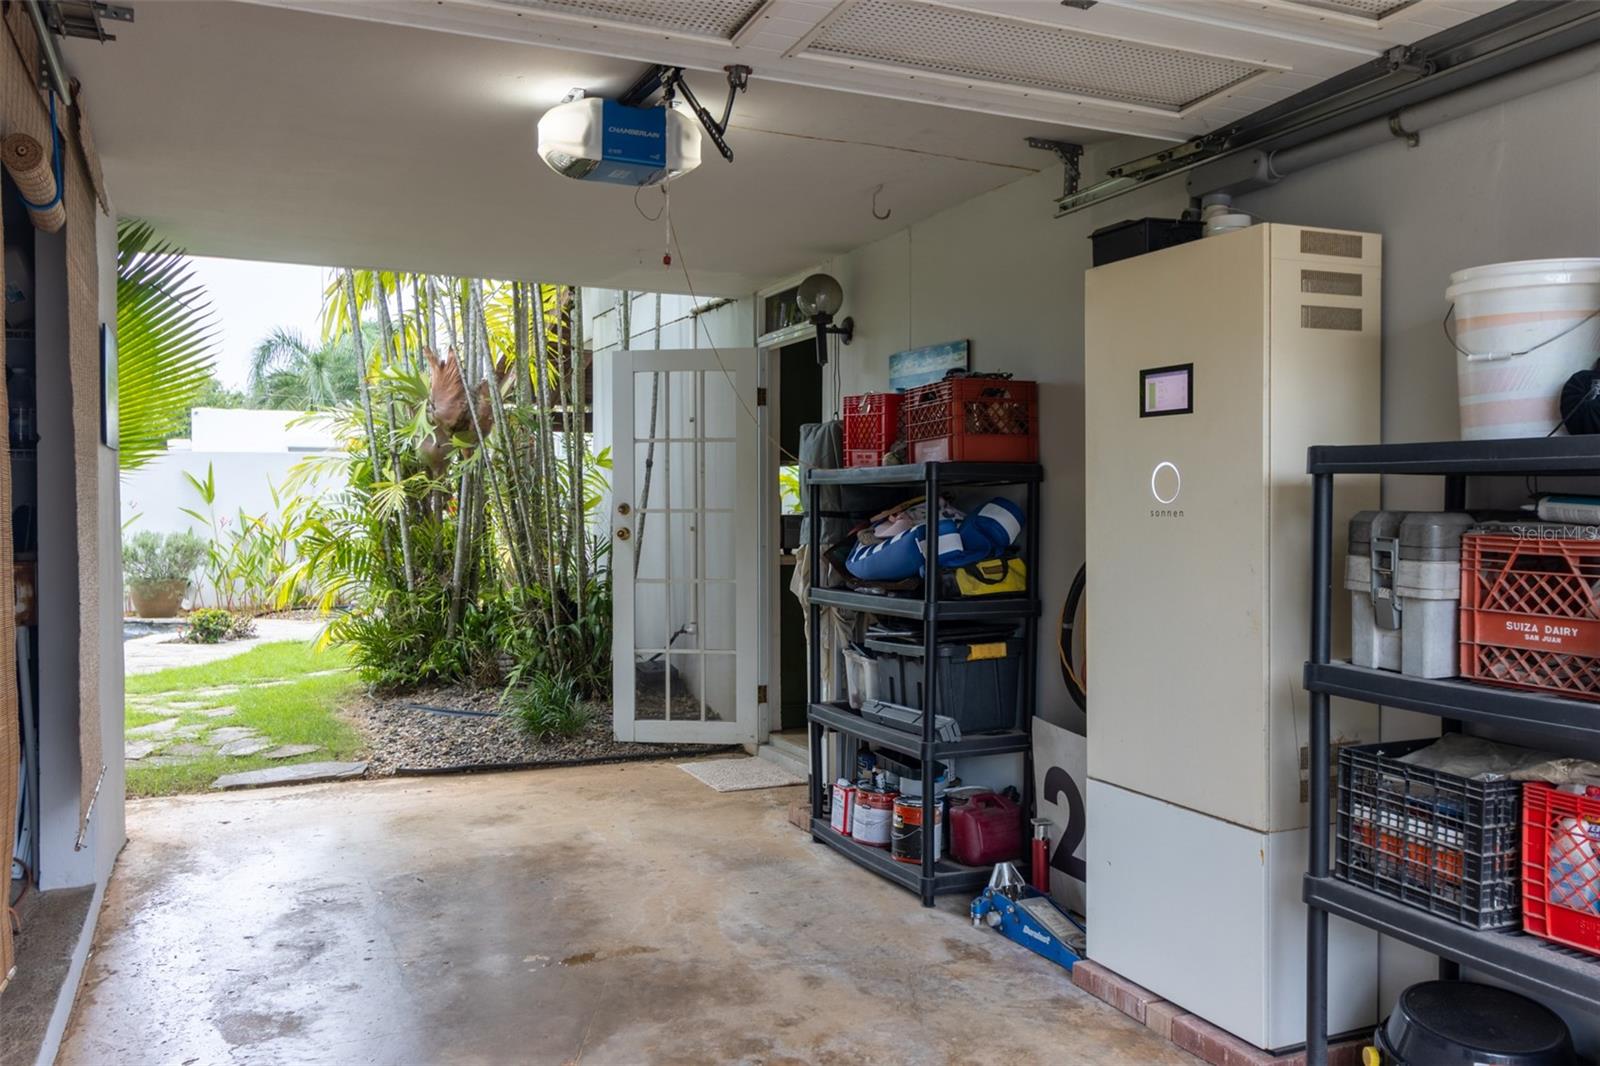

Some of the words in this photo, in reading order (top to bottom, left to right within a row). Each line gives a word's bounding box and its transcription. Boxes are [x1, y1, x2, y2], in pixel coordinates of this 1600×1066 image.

[608, 126, 660, 139] CHAMBERLAIN
[1150, 509, 1184, 518] sonnen
[1506, 621, 1539, 633] SUIZA
[1544, 625, 1579, 637] DAIRY
[1542, 636, 1562, 644] JUAN
[1044, 766, 1087, 882] 2
